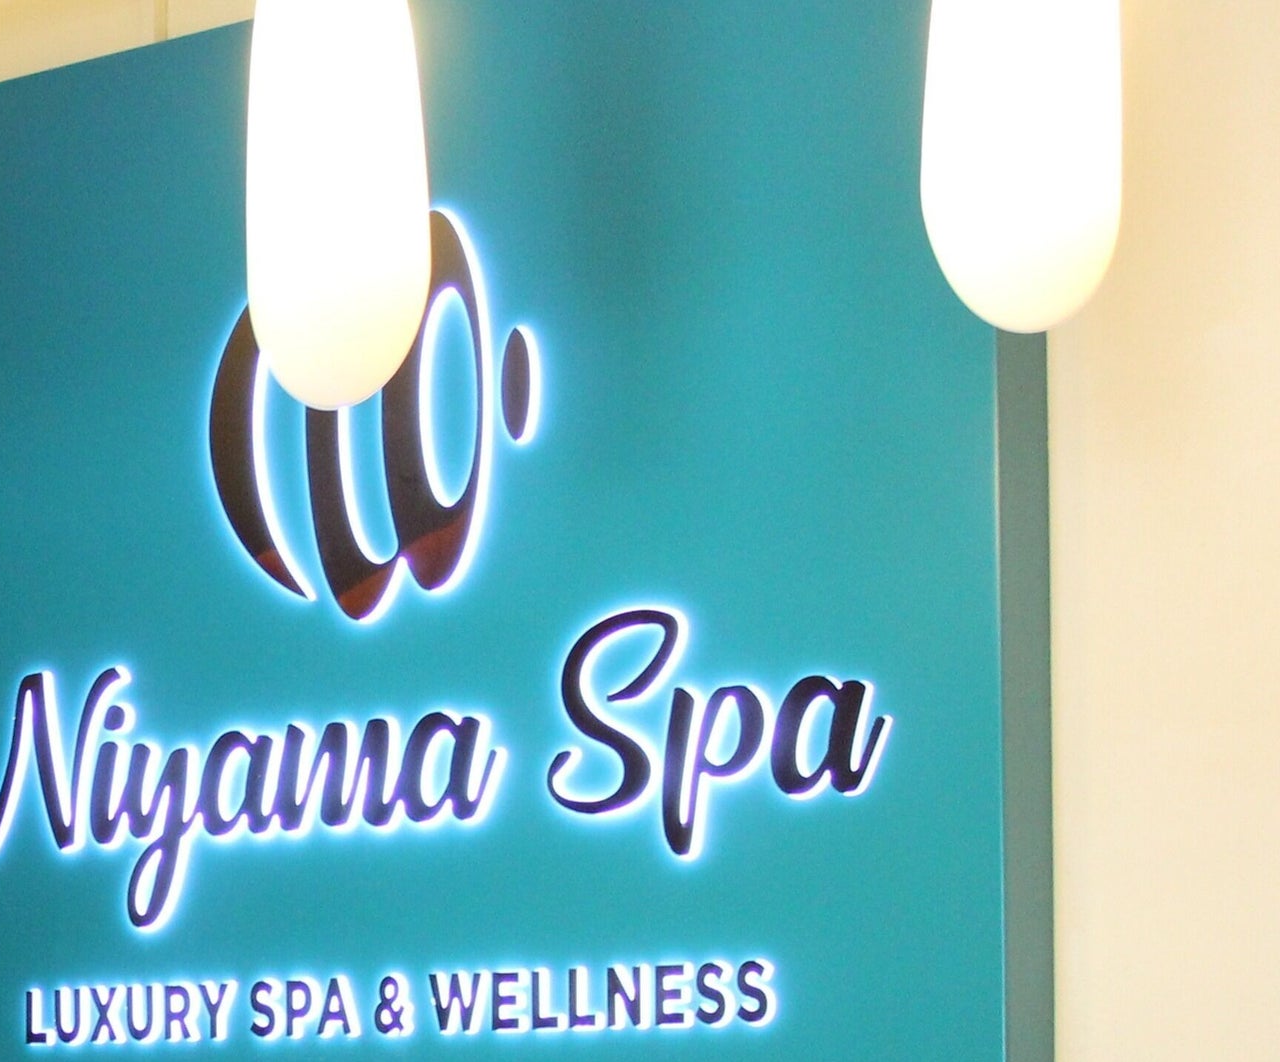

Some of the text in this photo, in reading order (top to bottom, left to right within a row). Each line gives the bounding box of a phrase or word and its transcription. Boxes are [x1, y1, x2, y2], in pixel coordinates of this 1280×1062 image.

[547, 608, 887, 858] Spa
[26, 960, 772, 1045] LUXURY SPA & WELLNESS
